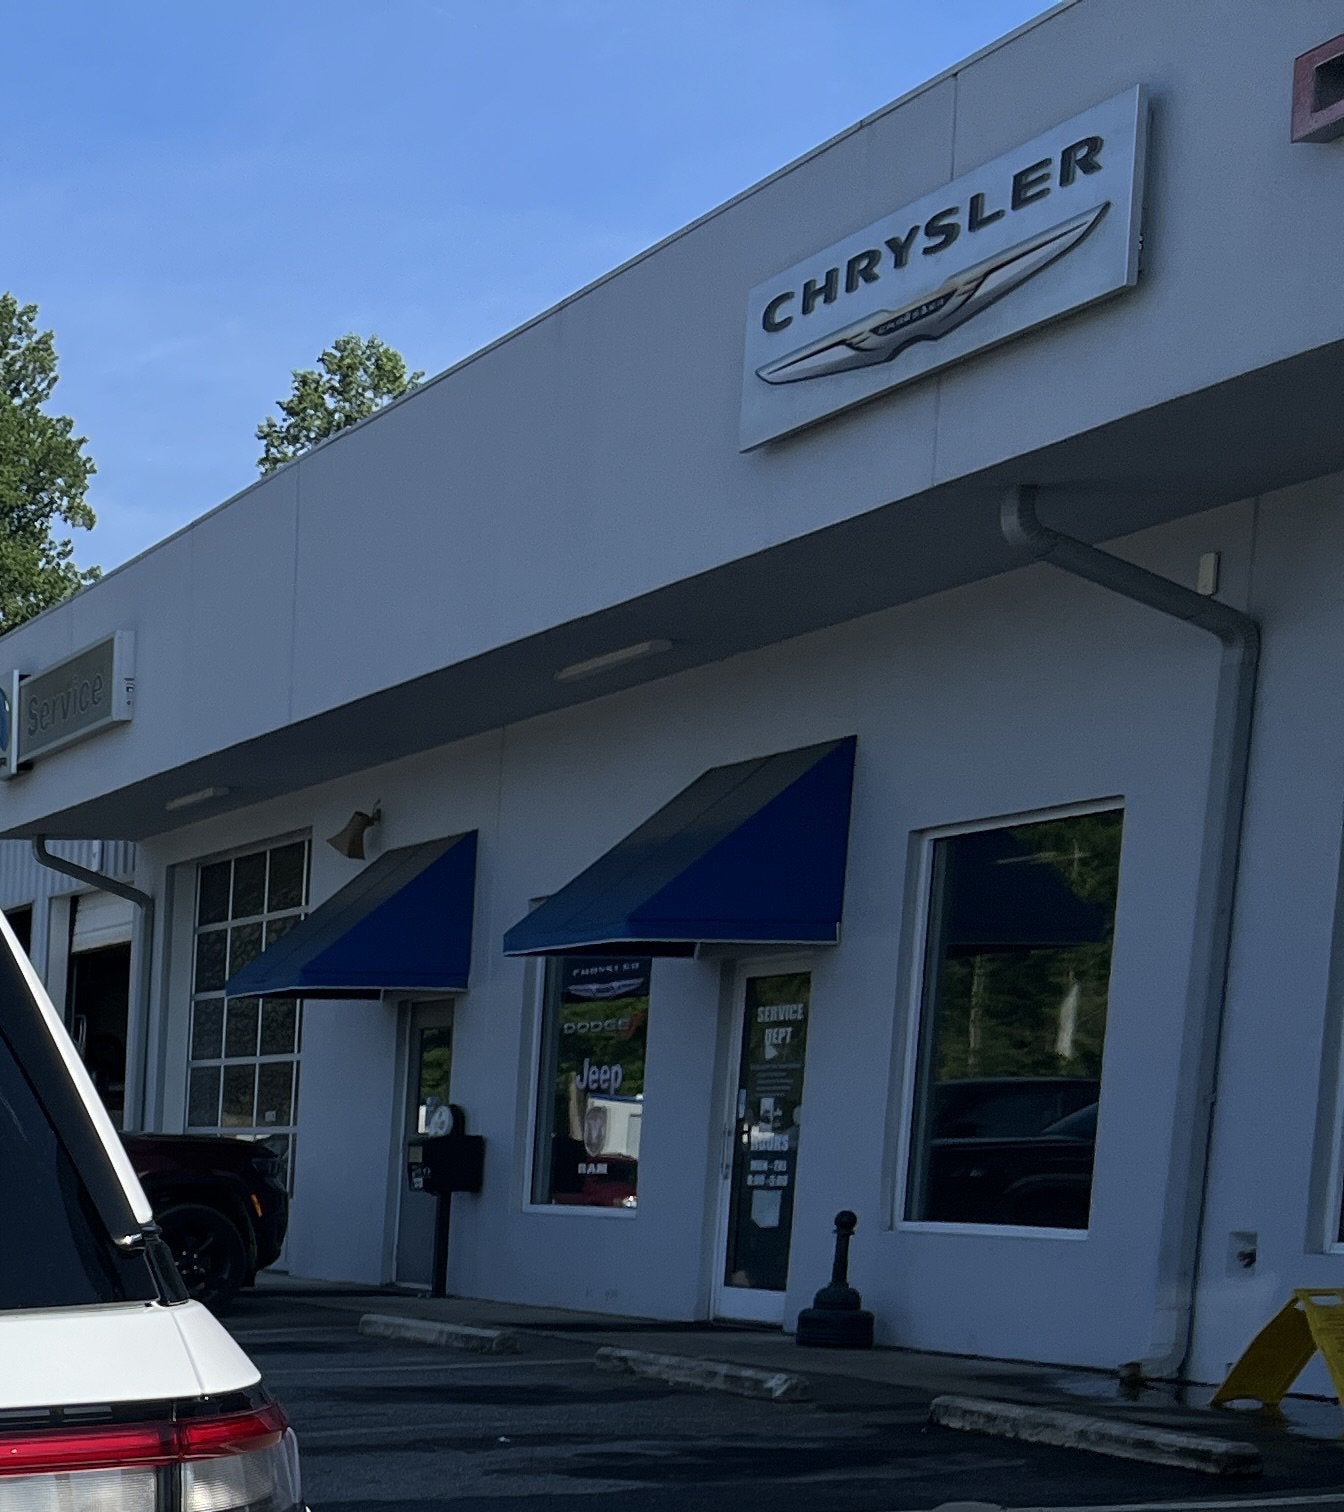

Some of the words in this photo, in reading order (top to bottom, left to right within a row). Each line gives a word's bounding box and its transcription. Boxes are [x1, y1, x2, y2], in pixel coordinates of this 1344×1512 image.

[762, 135, 1104, 332] CHRYSLER
[27, 672, 104, 737] Service
[757, 1003, 804, 1022] SERVICE
[765, 1027, 792, 1044] DEPT
[576, 1058, 623, 1095] Jeep
[577, 1162, 608, 1174] RAM
